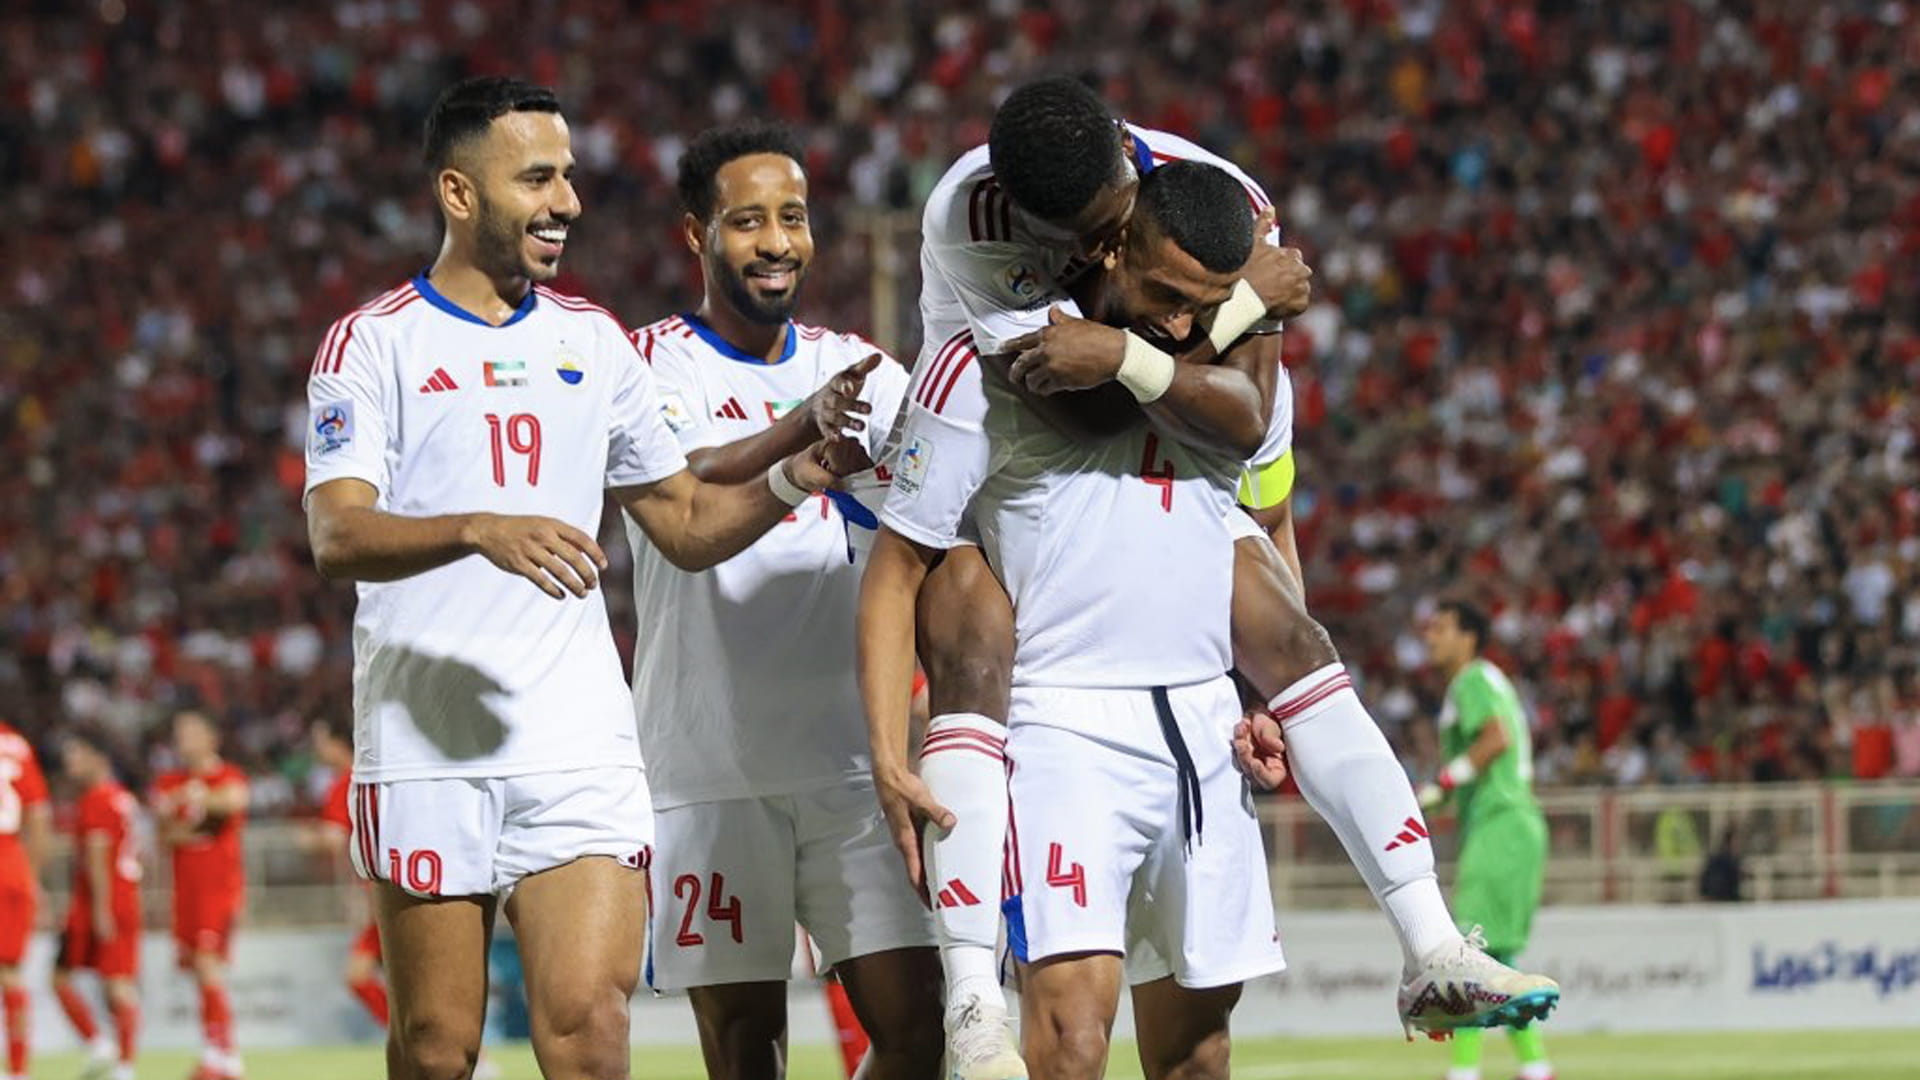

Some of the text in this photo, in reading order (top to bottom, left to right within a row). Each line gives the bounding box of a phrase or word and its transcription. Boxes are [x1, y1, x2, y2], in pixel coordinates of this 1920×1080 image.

[484, 413, 541, 487] 19
[1141, 432, 1174, 513] 4
[388, 848, 442, 895] 19
[1047, 842, 1086, 907] 4
[673, 872, 743, 947] 24
